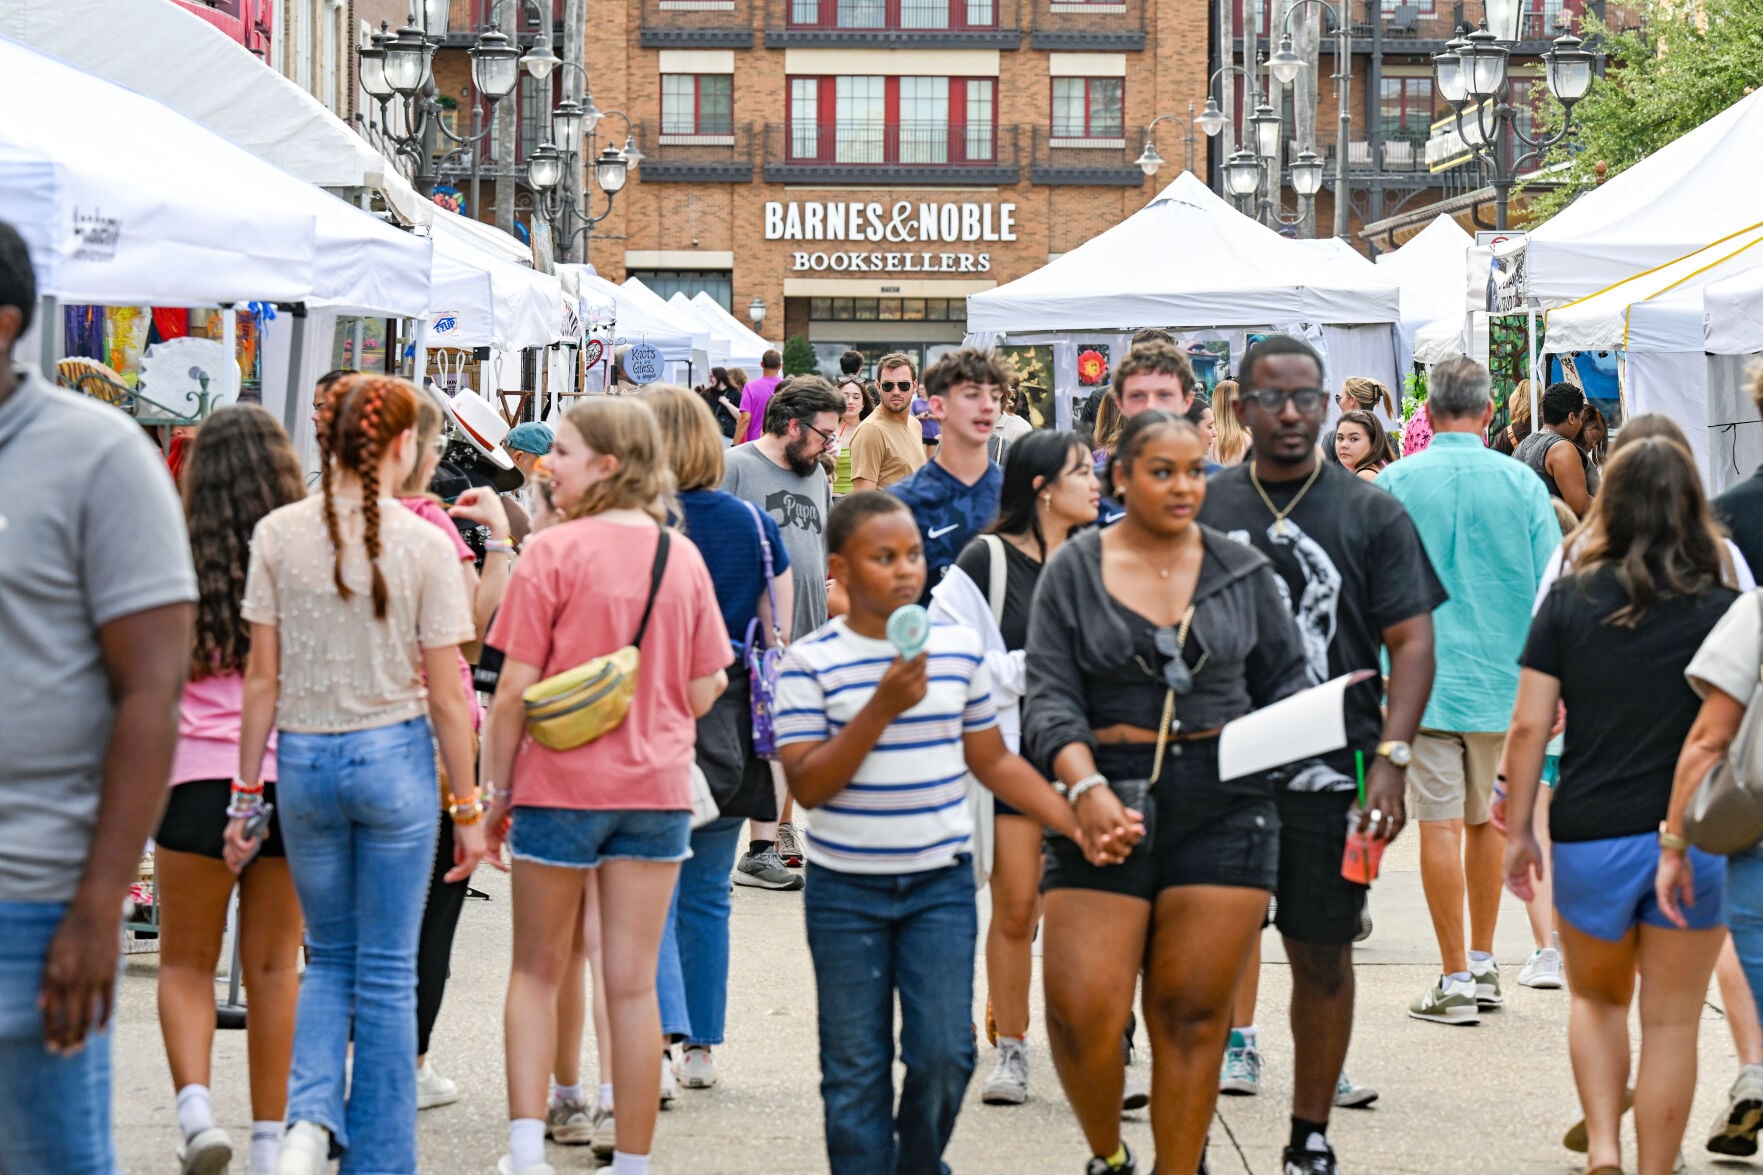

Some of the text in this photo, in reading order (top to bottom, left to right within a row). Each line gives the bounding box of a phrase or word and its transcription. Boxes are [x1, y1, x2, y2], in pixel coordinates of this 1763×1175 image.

[793, 252, 991, 272] BOOKSELLERS
[631, 346, 656, 361] Knots
[632, 361, 655, 374] Glass
[783, 494, 818, 523] Papa
